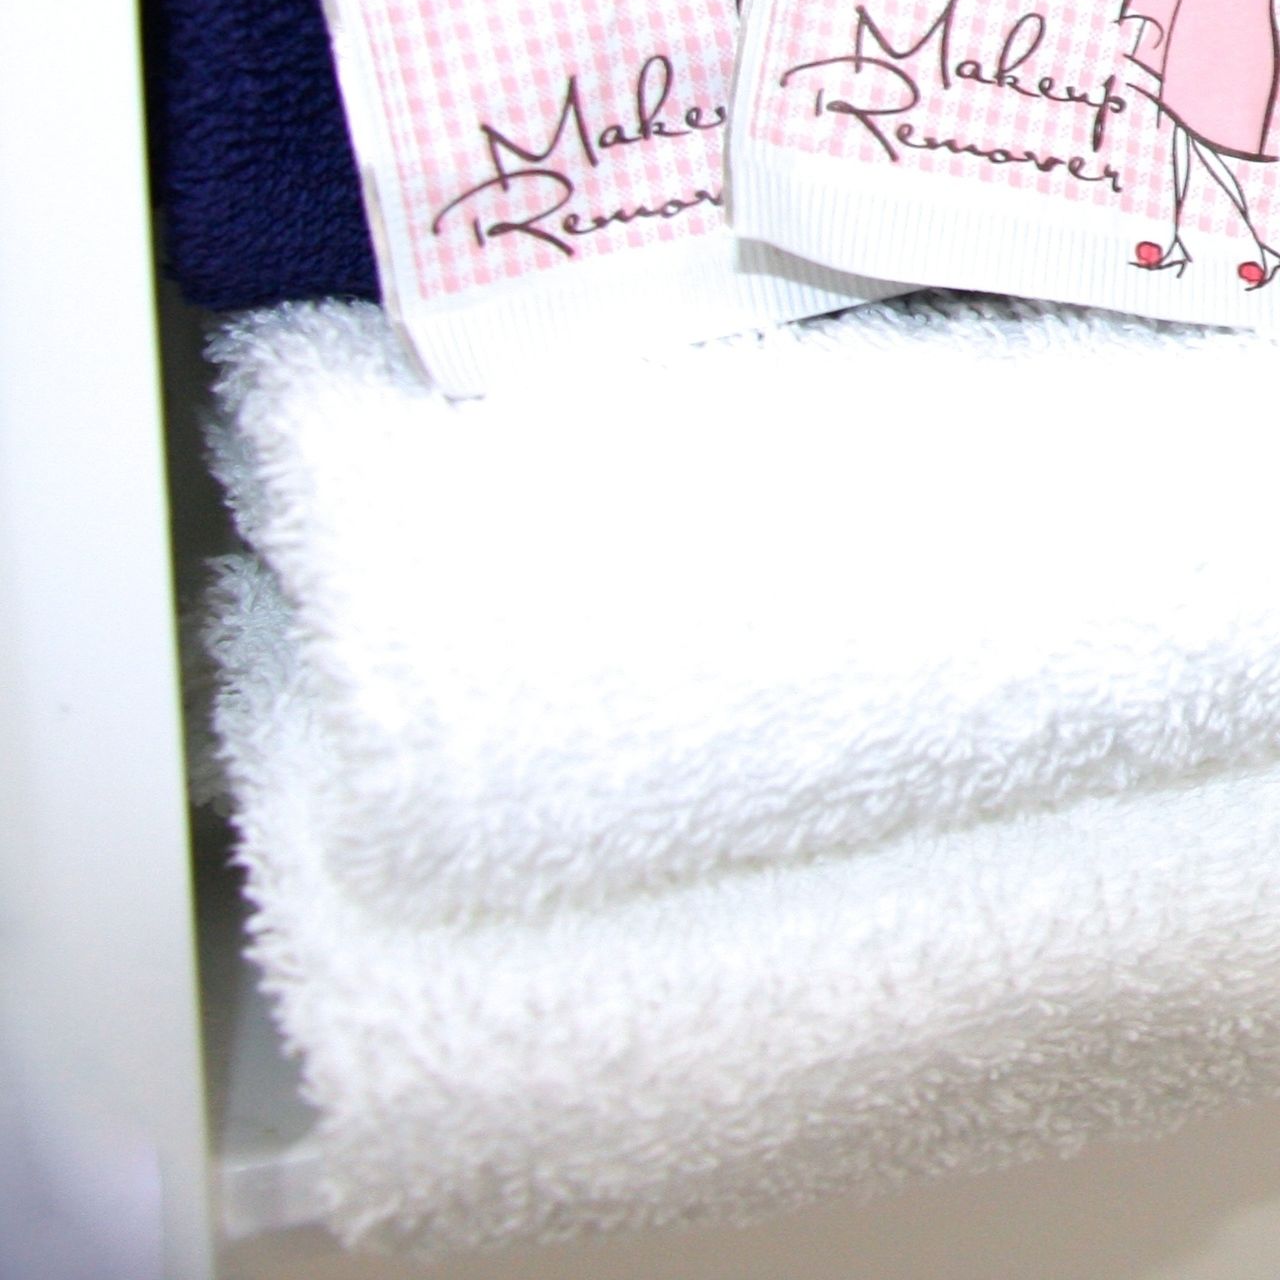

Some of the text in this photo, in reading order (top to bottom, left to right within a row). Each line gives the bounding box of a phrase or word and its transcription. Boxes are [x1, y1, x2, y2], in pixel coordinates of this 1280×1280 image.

[480, 55, 728, 192] Make
[780, 56, 1123, 193] Remover
[431, 169, 724, 256] Remov
